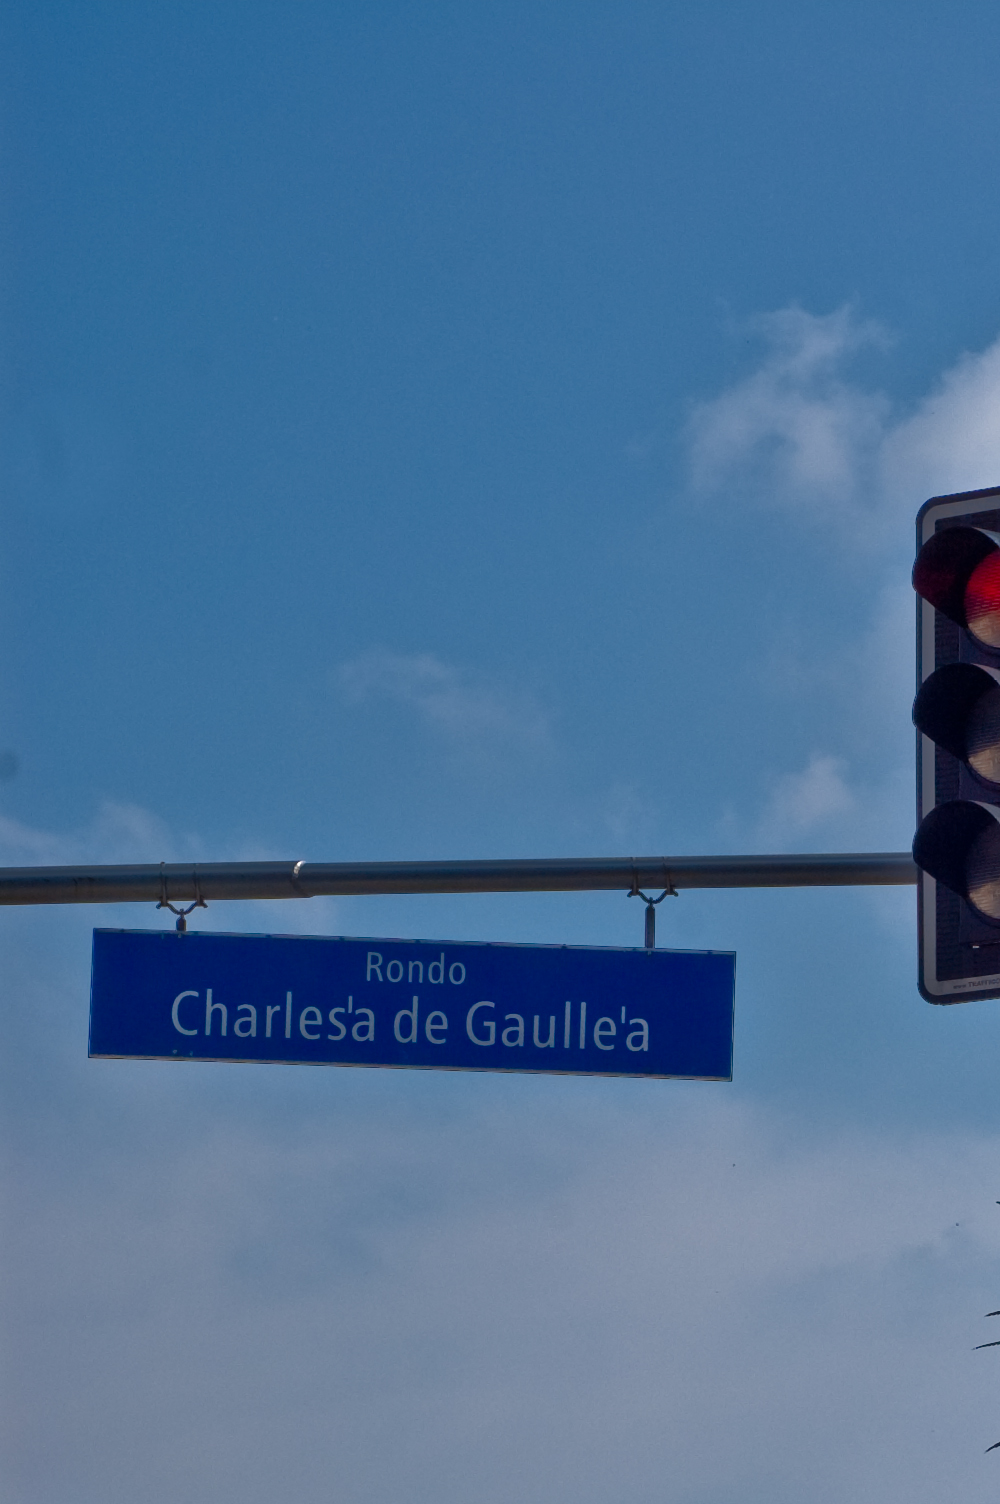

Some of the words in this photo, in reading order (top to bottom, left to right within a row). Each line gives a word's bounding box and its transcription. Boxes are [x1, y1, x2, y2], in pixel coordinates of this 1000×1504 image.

[366, 951, 467, 985] Rondo
[393, 995, 449, 1045] de
[465, 1000, 650, 1052] Gaulle'a
